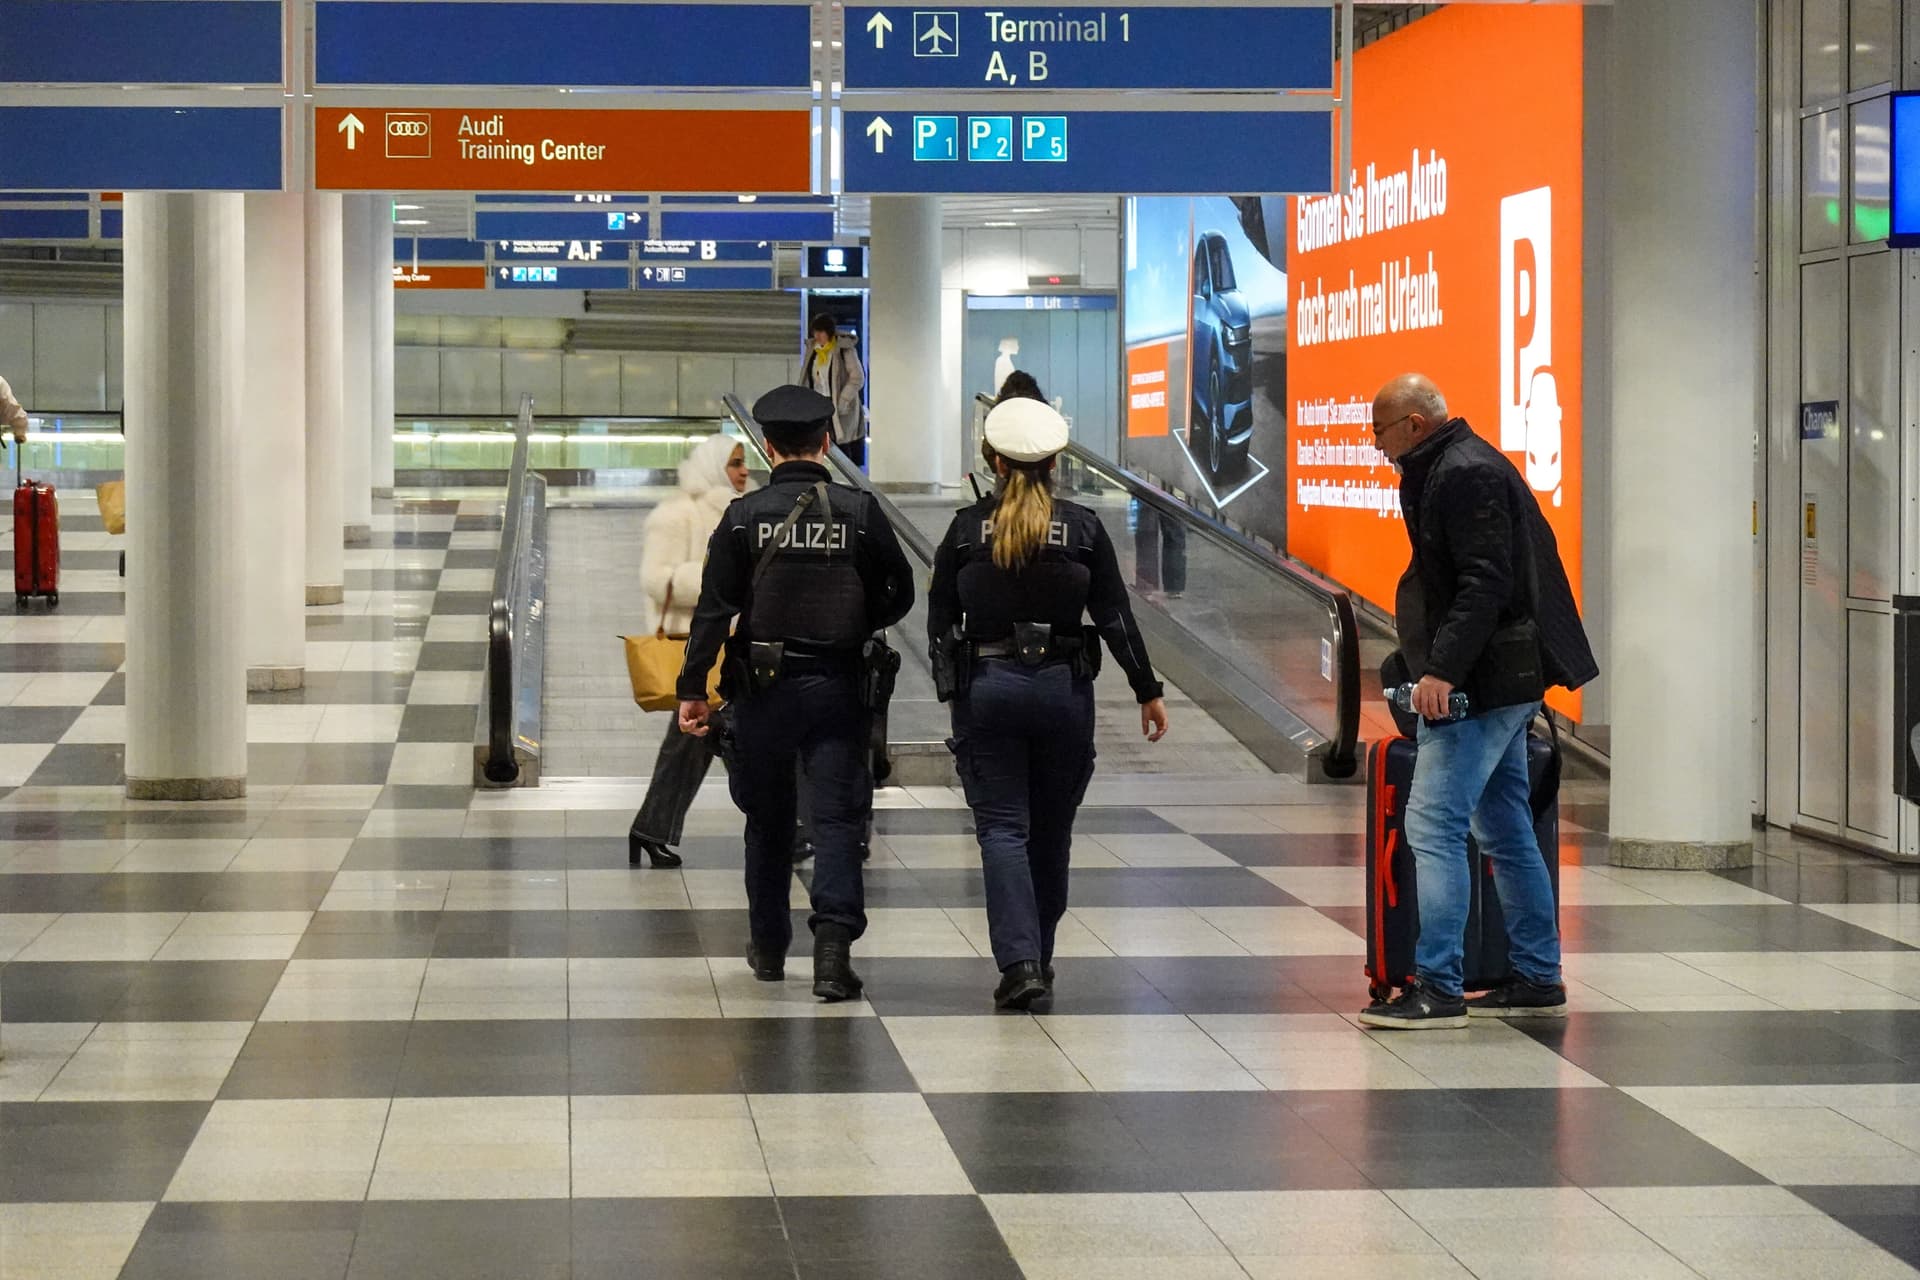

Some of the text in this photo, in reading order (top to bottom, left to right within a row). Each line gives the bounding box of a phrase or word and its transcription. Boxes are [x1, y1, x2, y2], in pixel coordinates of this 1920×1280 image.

[984, 12, 1129, 43] Terminal 1
[985, 51, 1048, 86] A, B
[458, 114, 503, 136] Audi
[458, 139, 606, 165] Training Center
[1366, 162, 1408, 235] Ihrem
[1410, 148, 1447, 222] Auto
[701, 240, 717, 261] B
[1297, 251, 1443, 347] doch auch mal Urlaub.
[758, 522, 846, 549] POLIZEI
